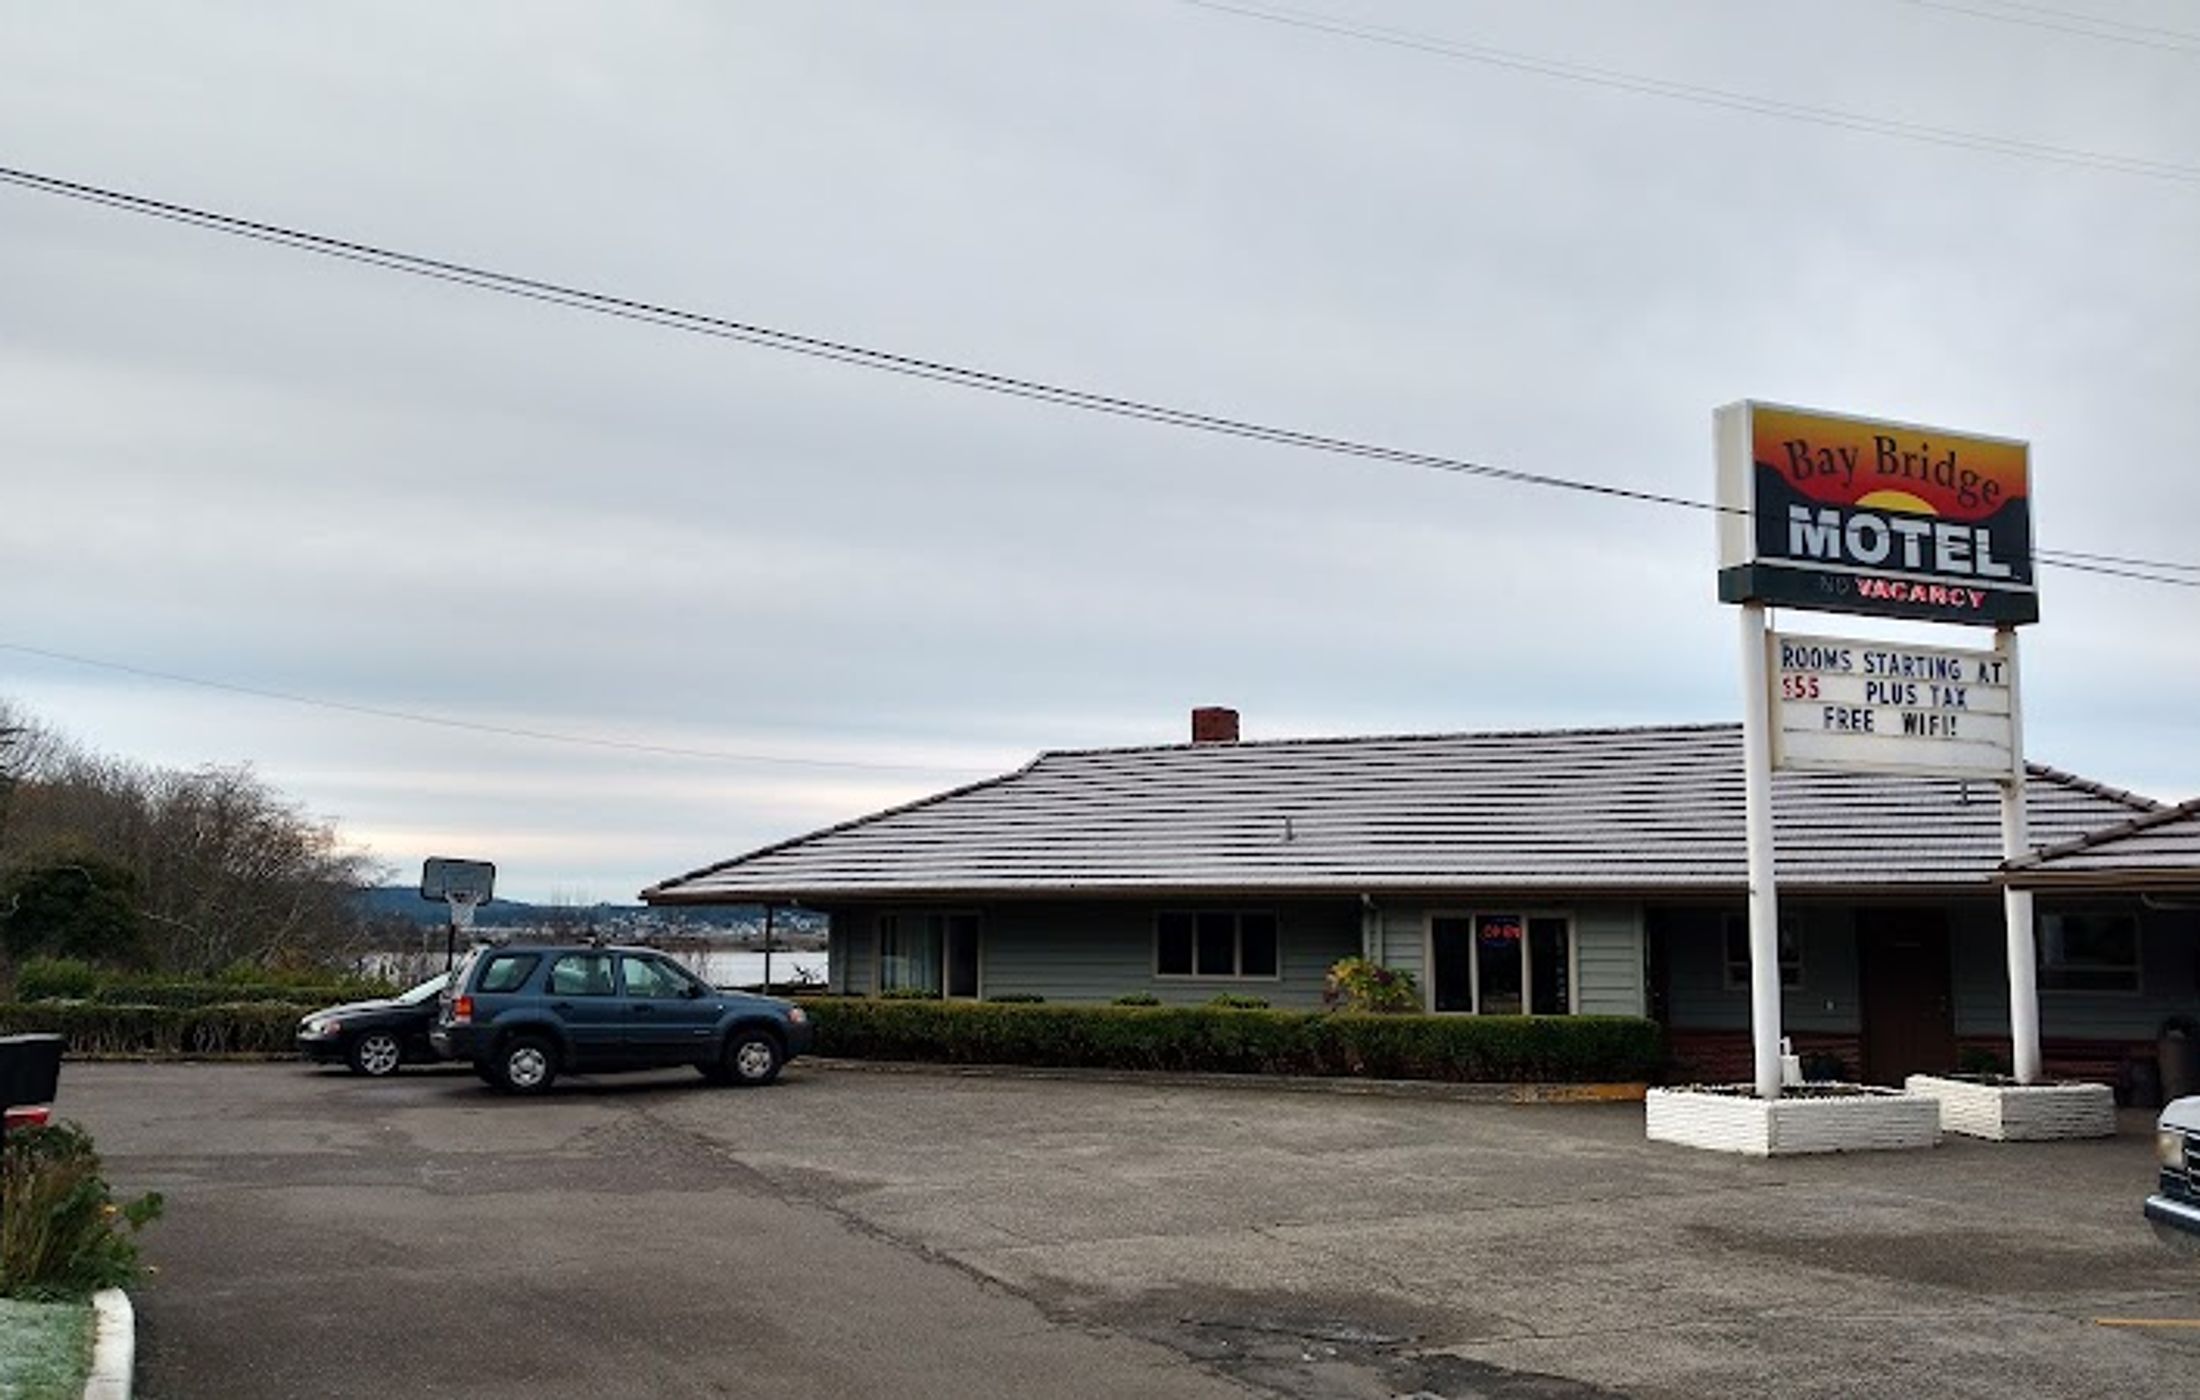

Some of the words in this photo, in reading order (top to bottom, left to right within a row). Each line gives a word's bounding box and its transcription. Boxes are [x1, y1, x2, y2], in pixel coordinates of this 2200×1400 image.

[1783, 438, 1859, 489] Bay
[1873, 435, 2000, 509] Bridge
[1788, 503, 2012, 577] MOTEL
[1856, 577, 1986, 609] VACANCY
[1782, 646, 1852, 670] ROOMS
[1863, 652, 1962, 681] STARTING
[1979, 662, 2003, 684] AT
[1782, 675, 1820, 699] $55
[1866, 681, 1919, 705] PLUS
[1930, 685, 1968, 711] TAX
[1823, 706, 1875, 733] FREE
